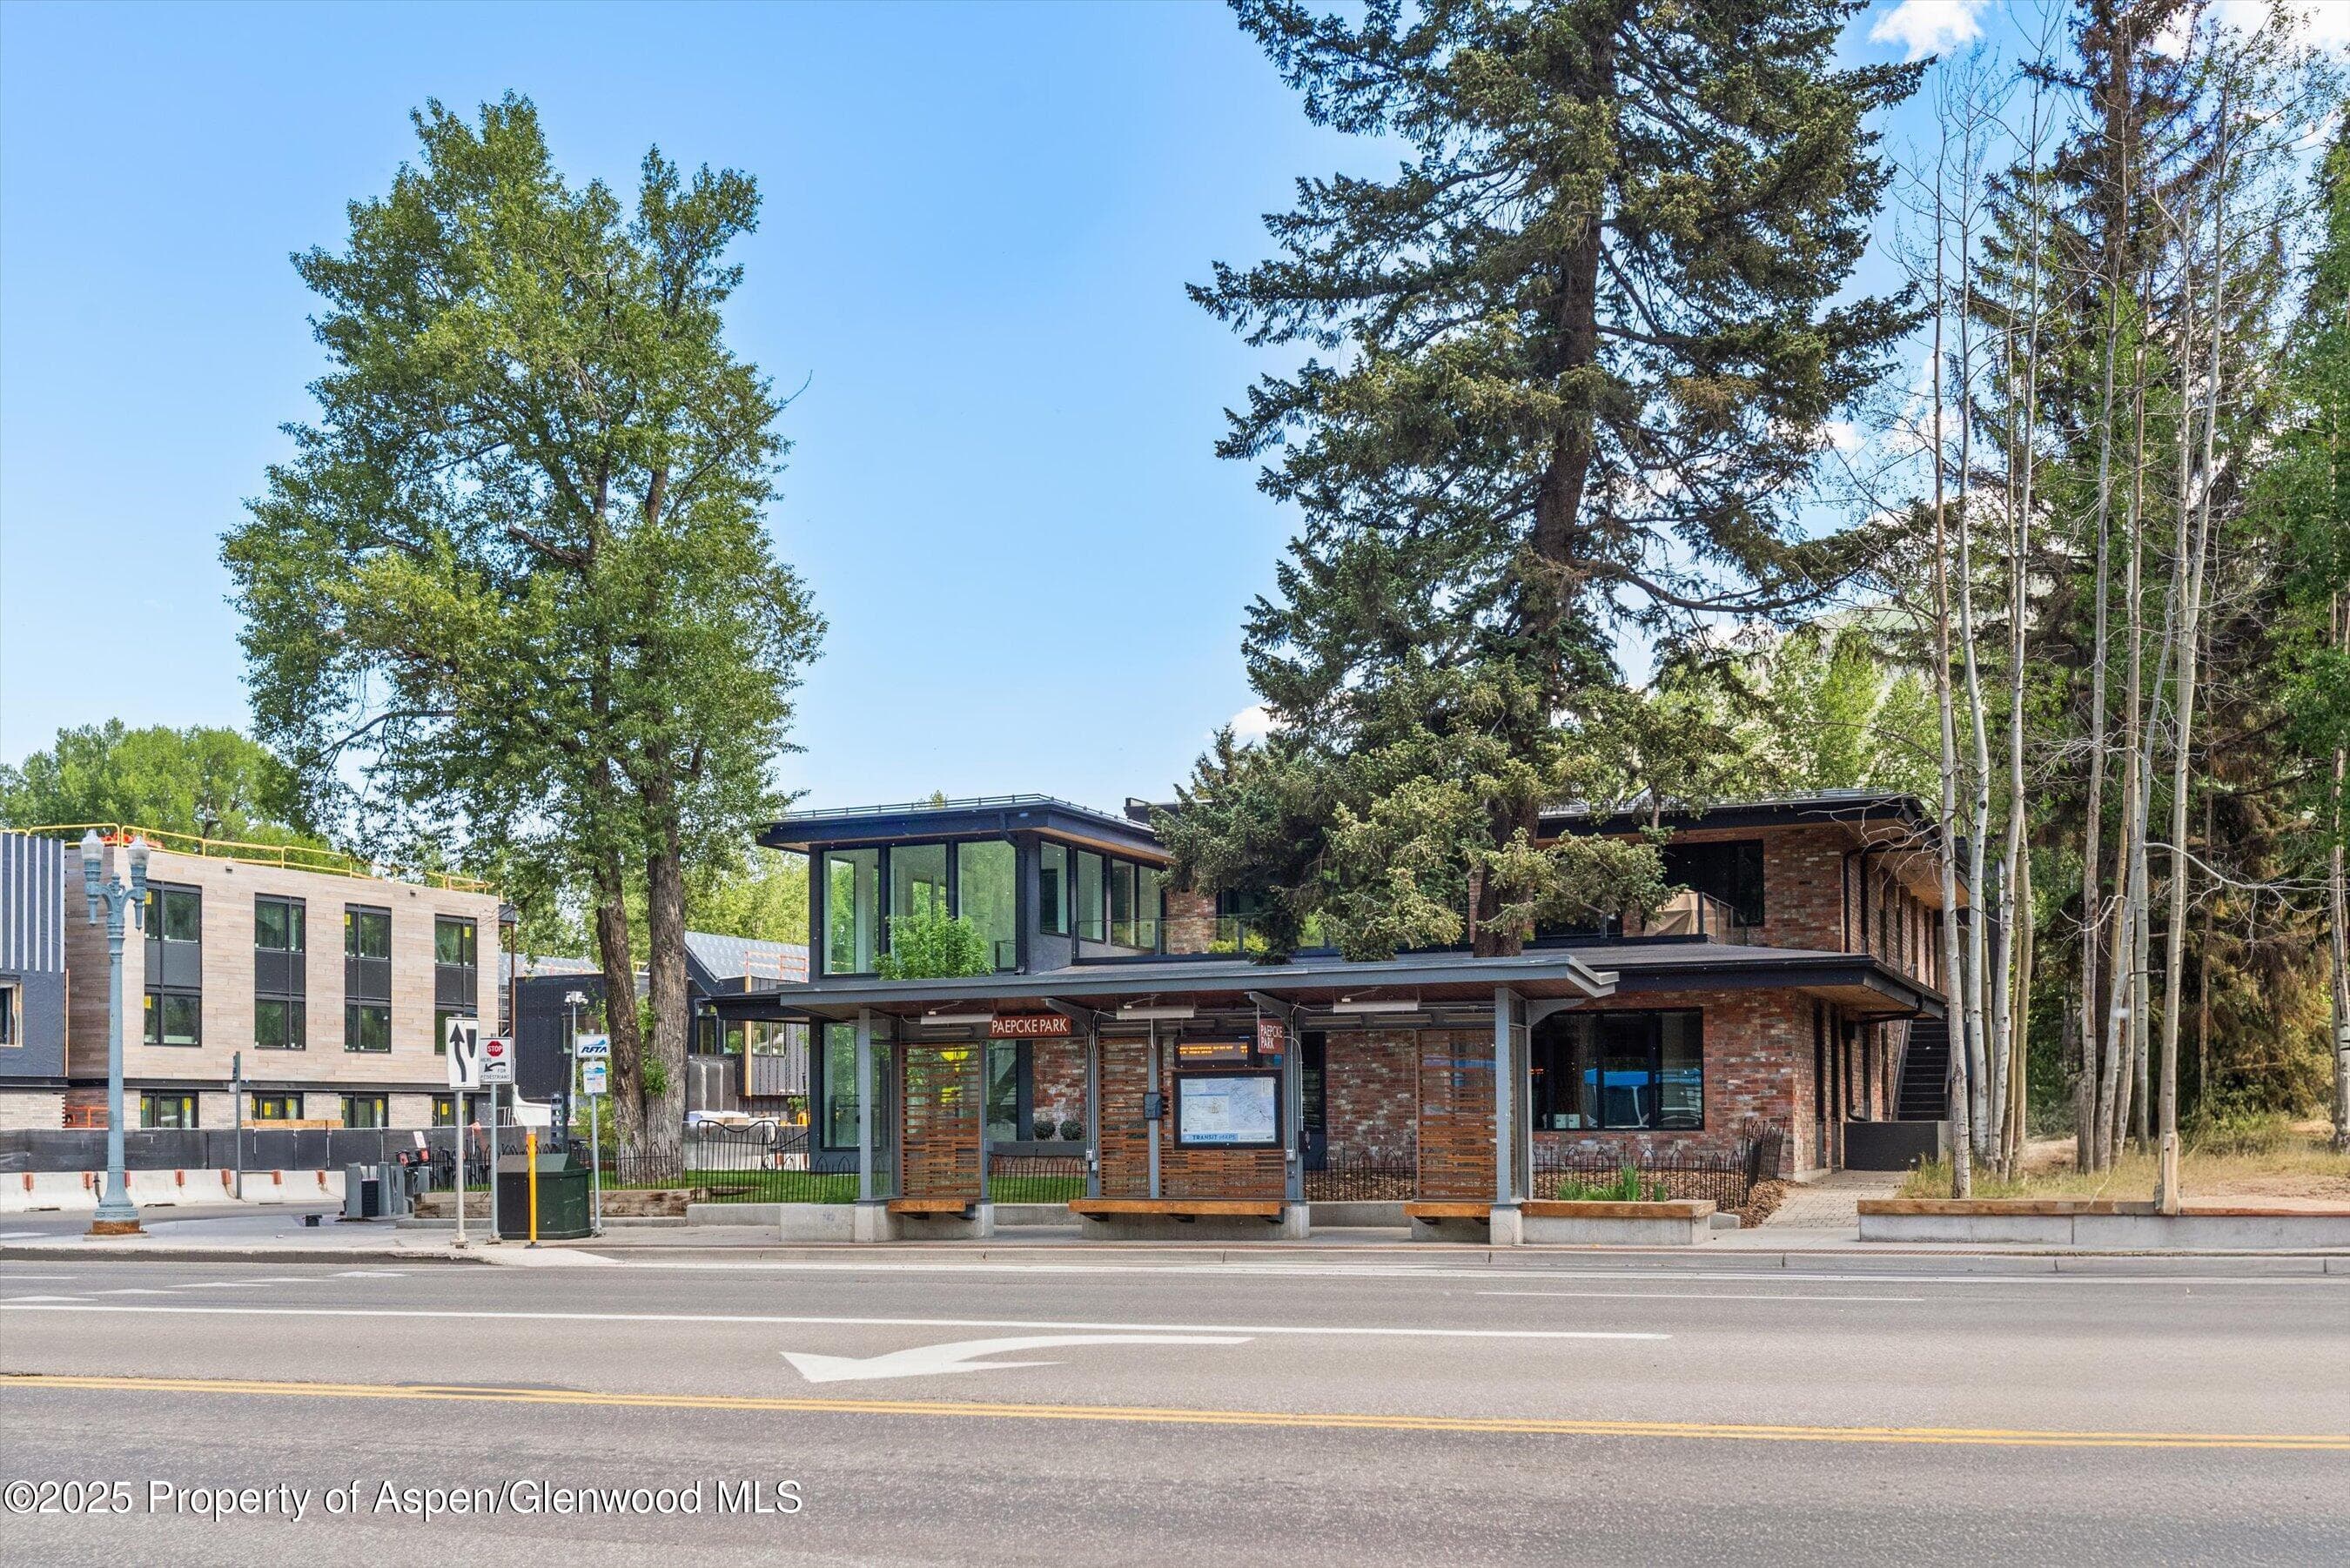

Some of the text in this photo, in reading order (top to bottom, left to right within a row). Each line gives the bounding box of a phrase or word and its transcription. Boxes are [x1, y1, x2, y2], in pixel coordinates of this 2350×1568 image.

[992, 1018, 1067, 1034] PAEPCKE PARK
[1260, 1024, 1283, 1038] PAEPCKE
[1260, 1036, 1275, 1049] PARK
